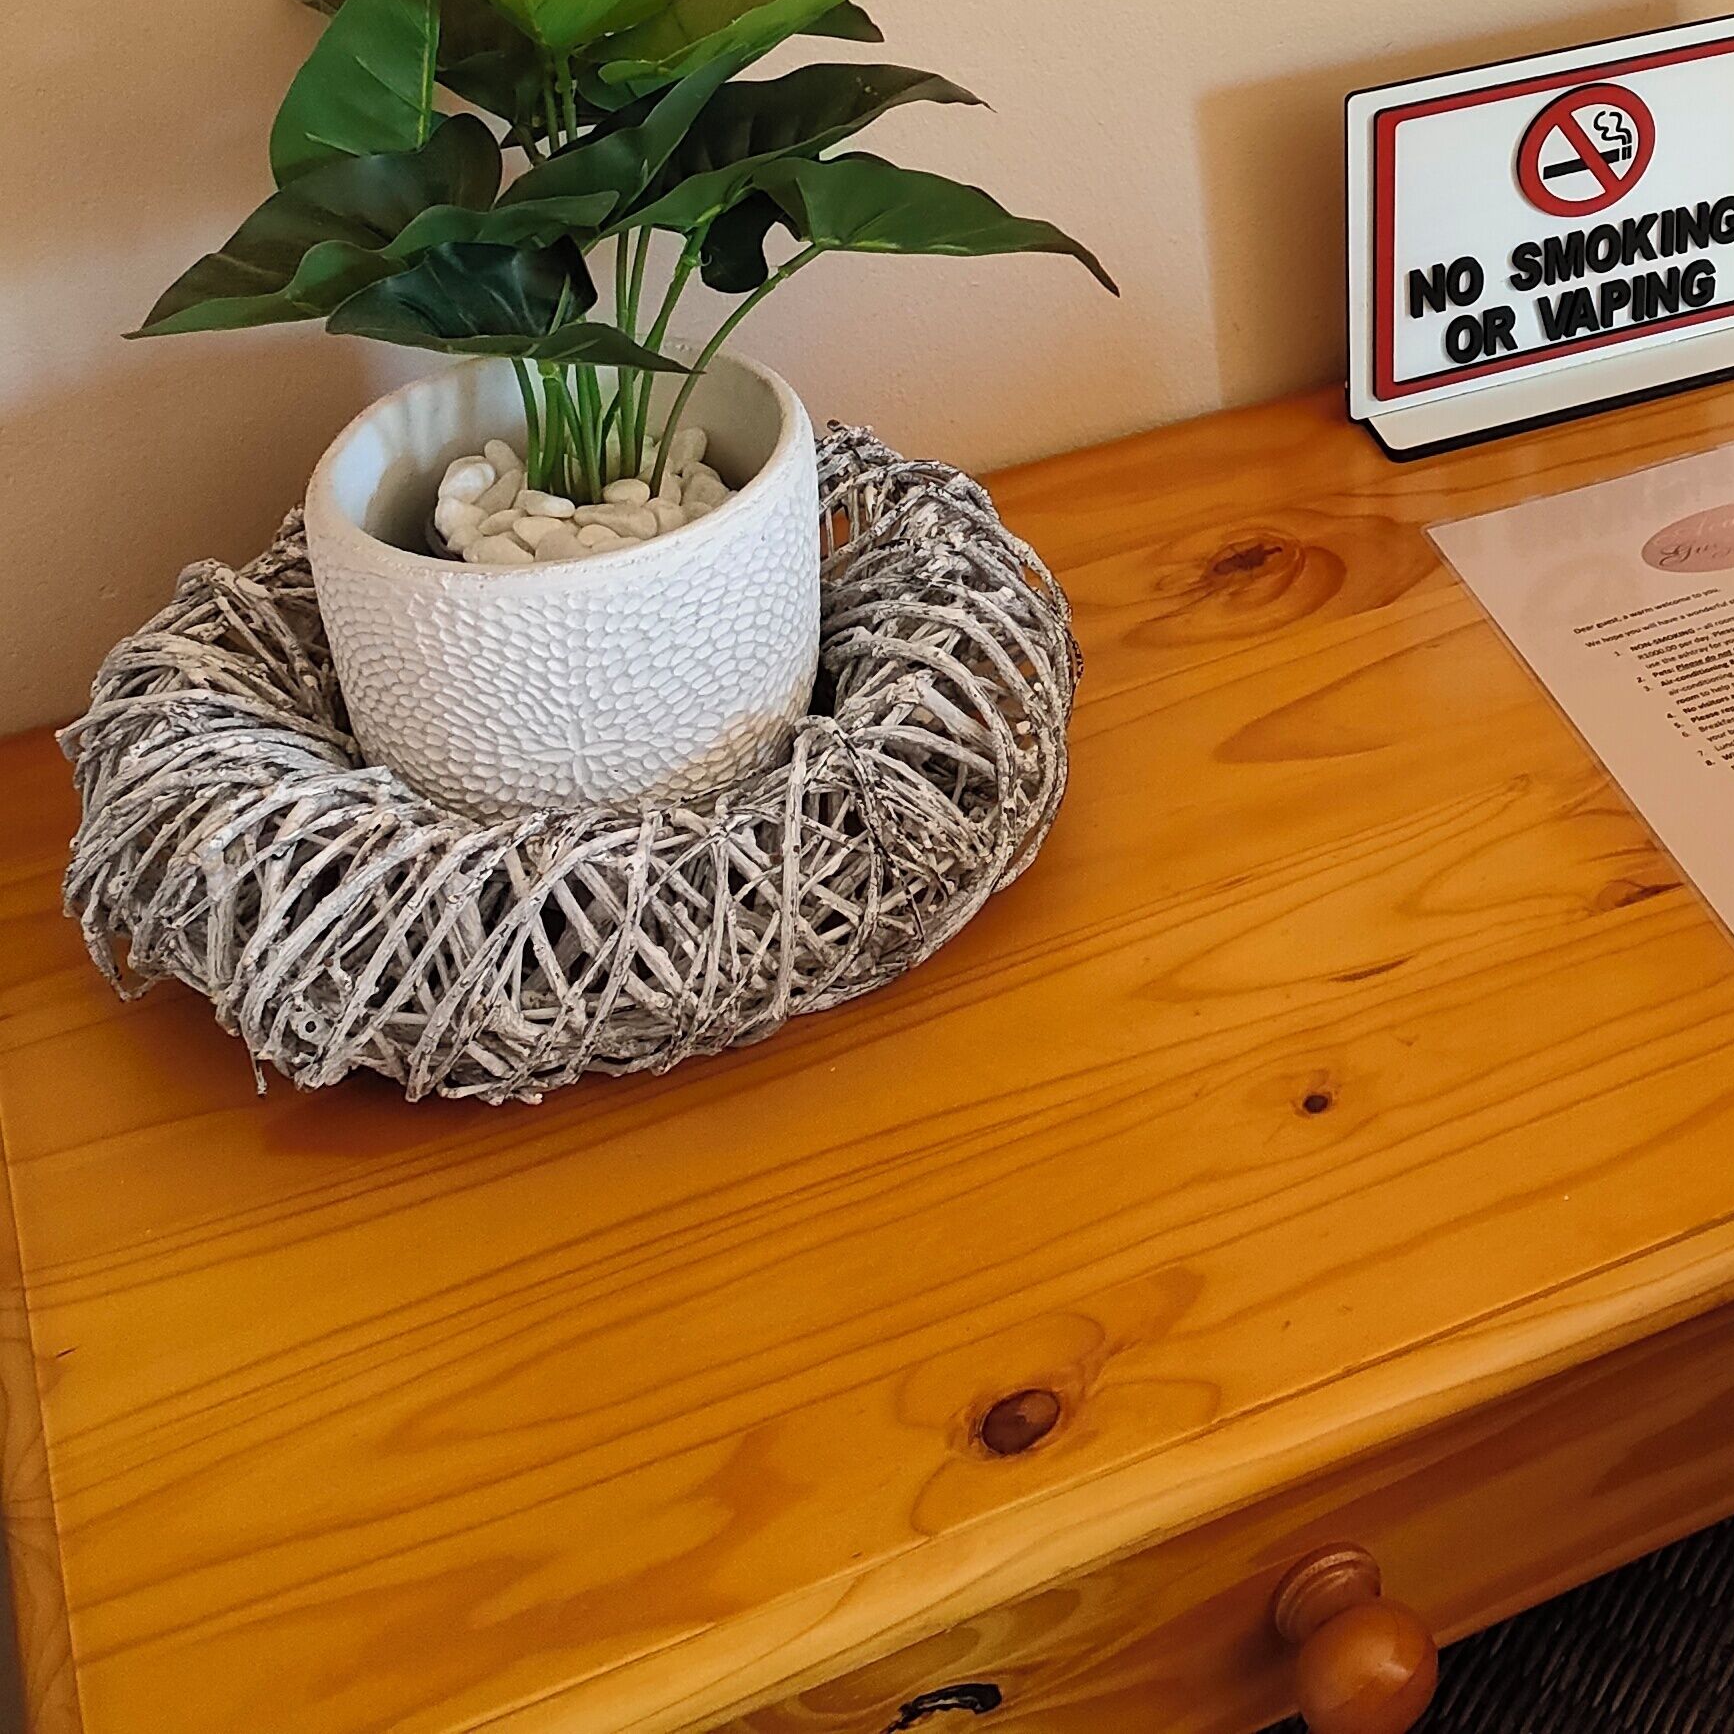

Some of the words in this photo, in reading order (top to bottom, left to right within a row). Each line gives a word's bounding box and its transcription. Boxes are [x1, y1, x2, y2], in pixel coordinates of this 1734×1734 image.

[1408, 256, 1484, 319] NO
[1445, 304, 1519, 364] OR
[1537, 259, 1717, 342] VAPING
[1573, 625, 1593, 633] Dear
[1596, 617, 1621, 628] guest,
[1629, 607, 1653, 616] warm
[1654, 596, 1690, 609] welcome
[1630, 628, 1694, 650] NON-SMOKING
[1690, 711, 1719, 722] Please
[1697, 696, 1729, 708] visitors
